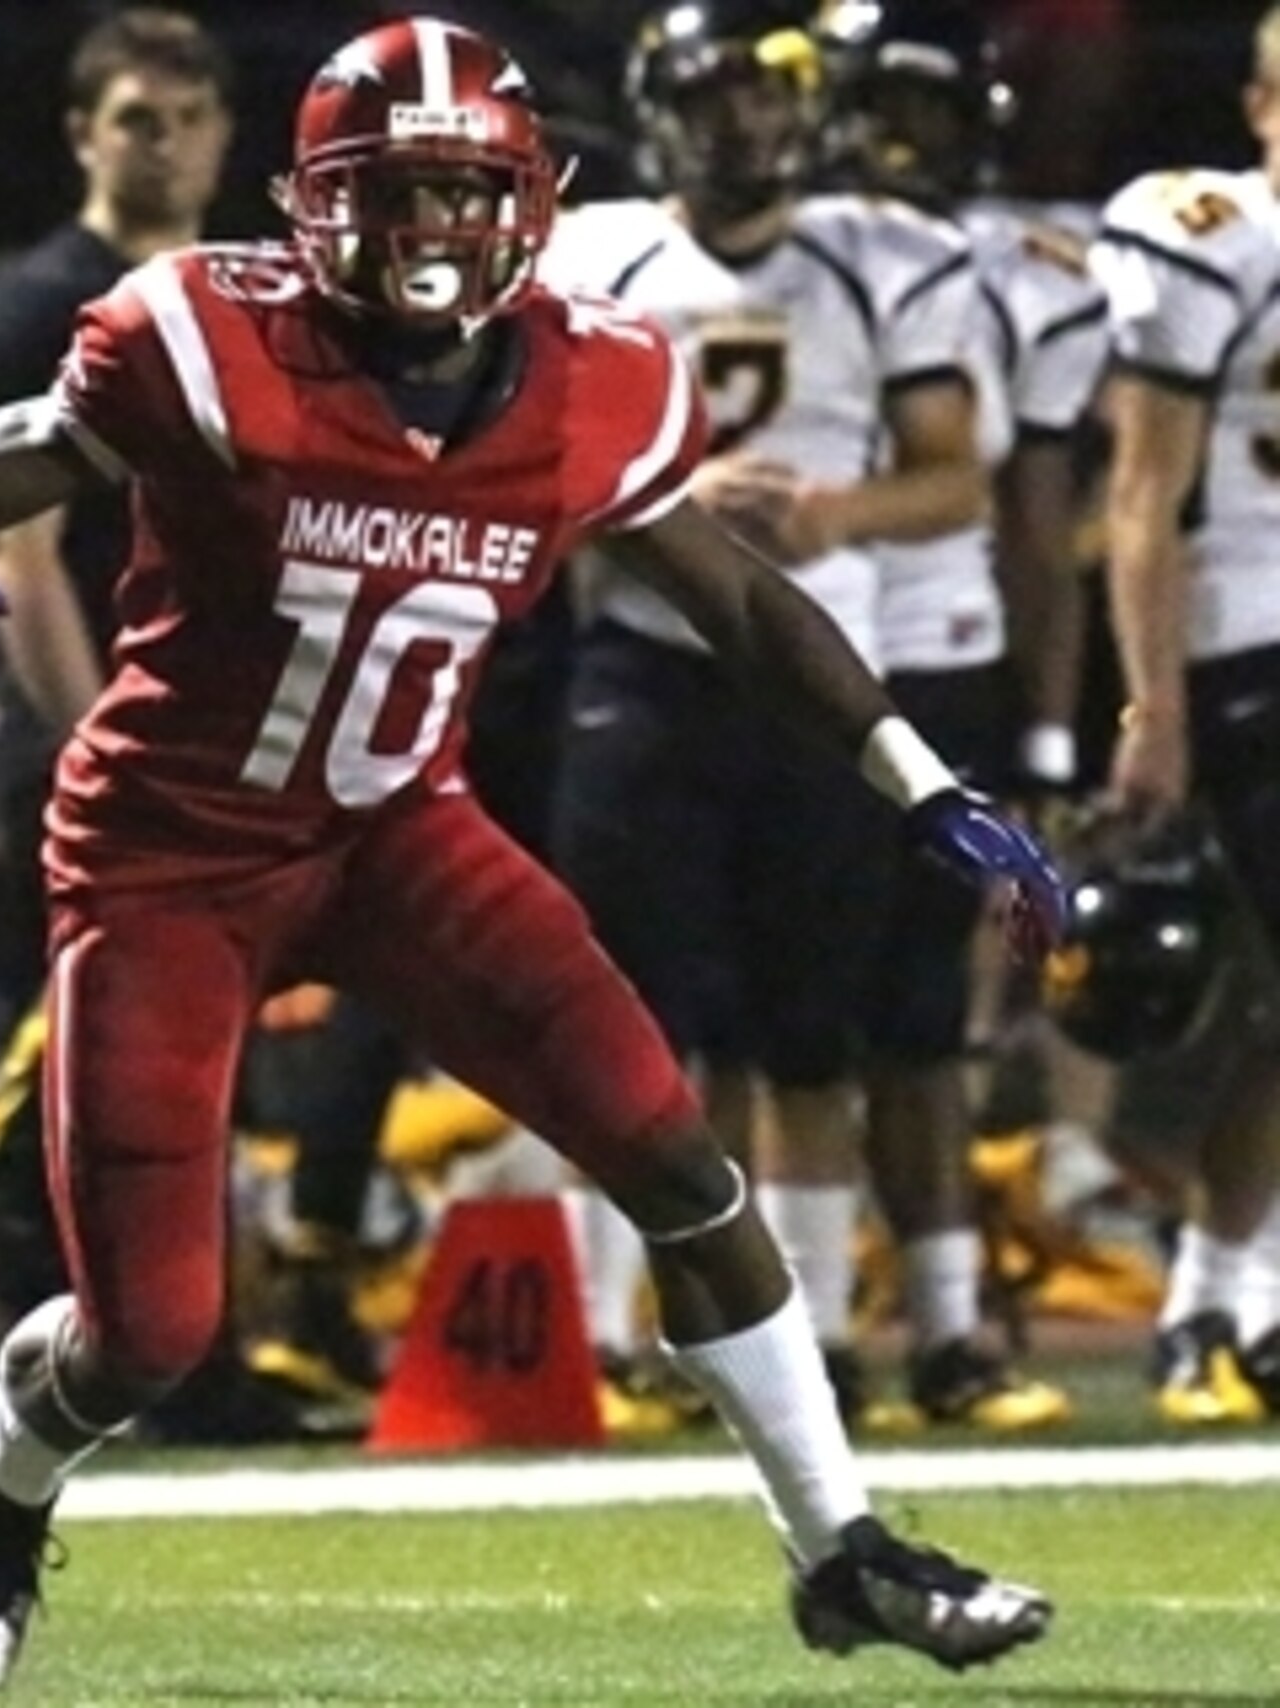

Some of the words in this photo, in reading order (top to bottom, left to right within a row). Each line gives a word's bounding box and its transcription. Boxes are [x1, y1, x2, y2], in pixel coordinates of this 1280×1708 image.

[279, 497, 538, 584] IMMOKALEE
[238, 559, 499, 809] 10
[443, 1255, 551, 1374] 40
